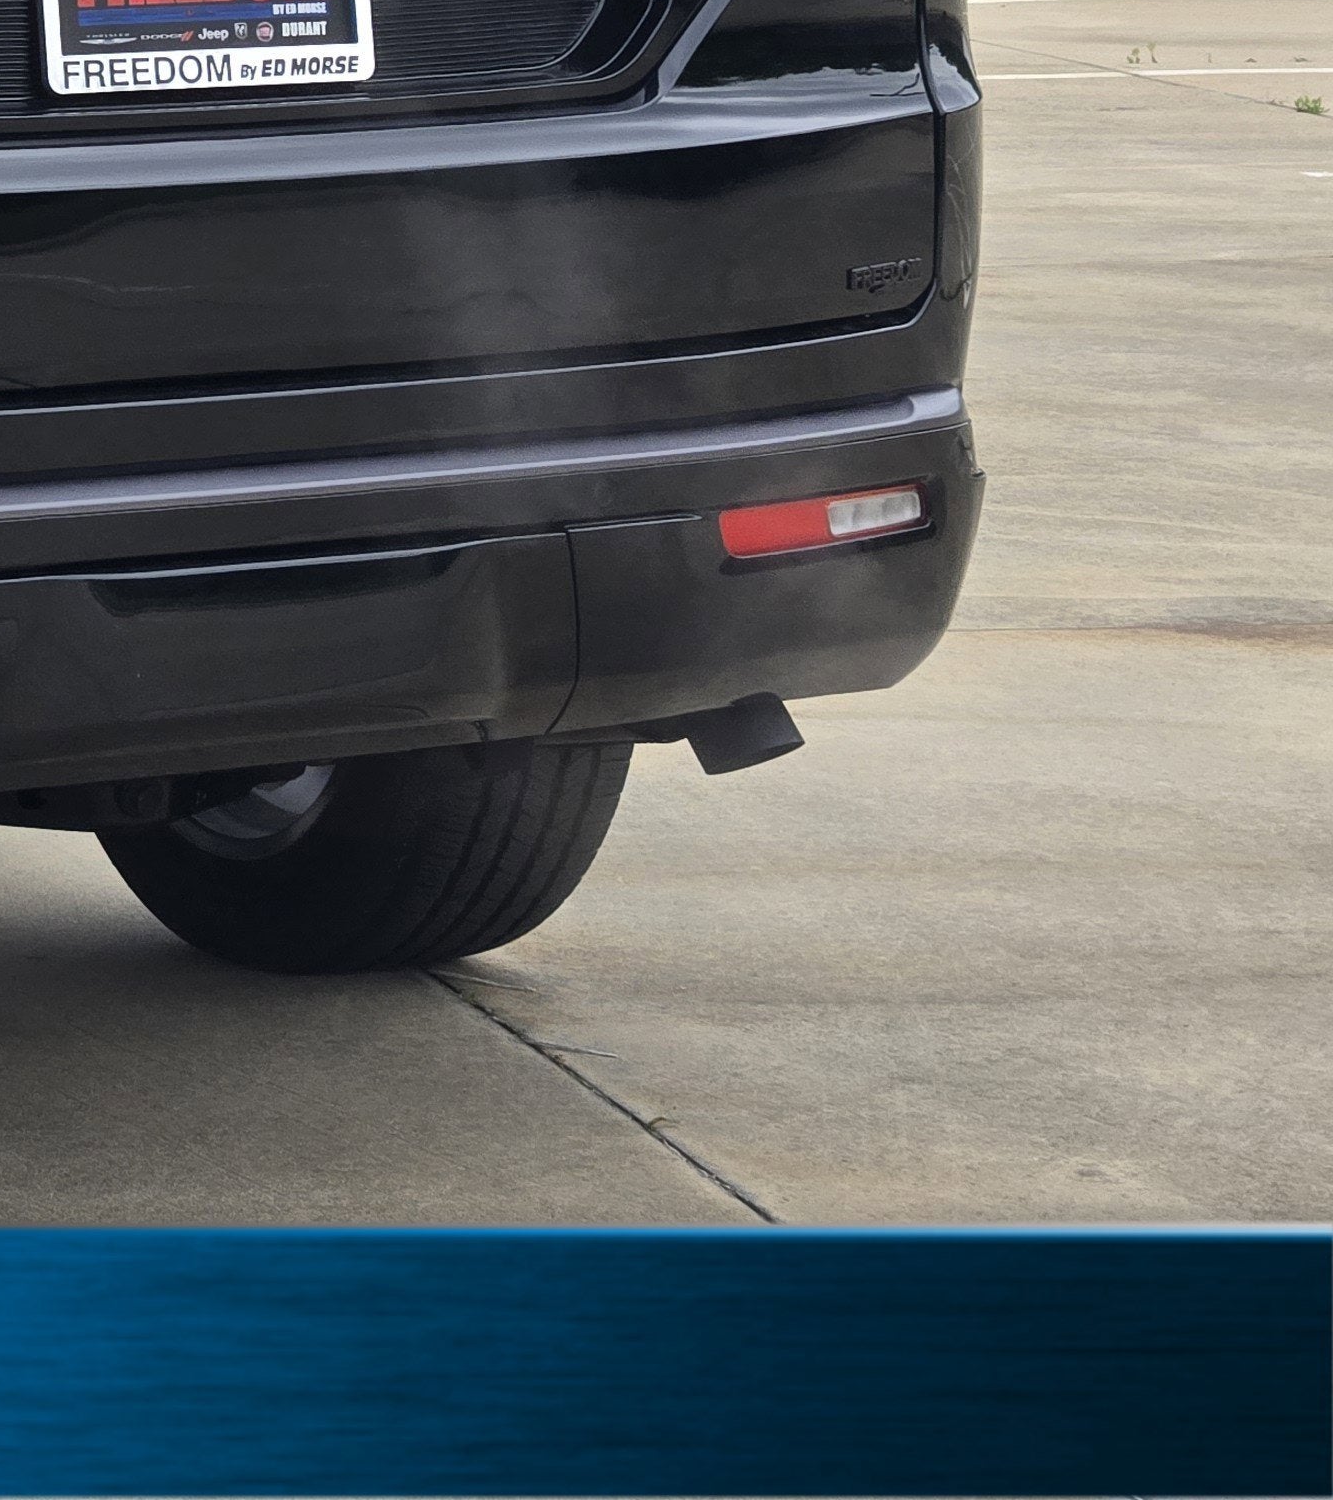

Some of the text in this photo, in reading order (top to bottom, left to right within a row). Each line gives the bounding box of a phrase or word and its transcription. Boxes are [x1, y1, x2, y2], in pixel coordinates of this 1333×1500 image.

[198, 27, 229, 41] Jeep
[282, 21, 328, 37] DURANT
[63, 54, 232, 89] FREEDOM
[262, 60, 286, 78] ED
[291, 55, 360, 77] MORSE
